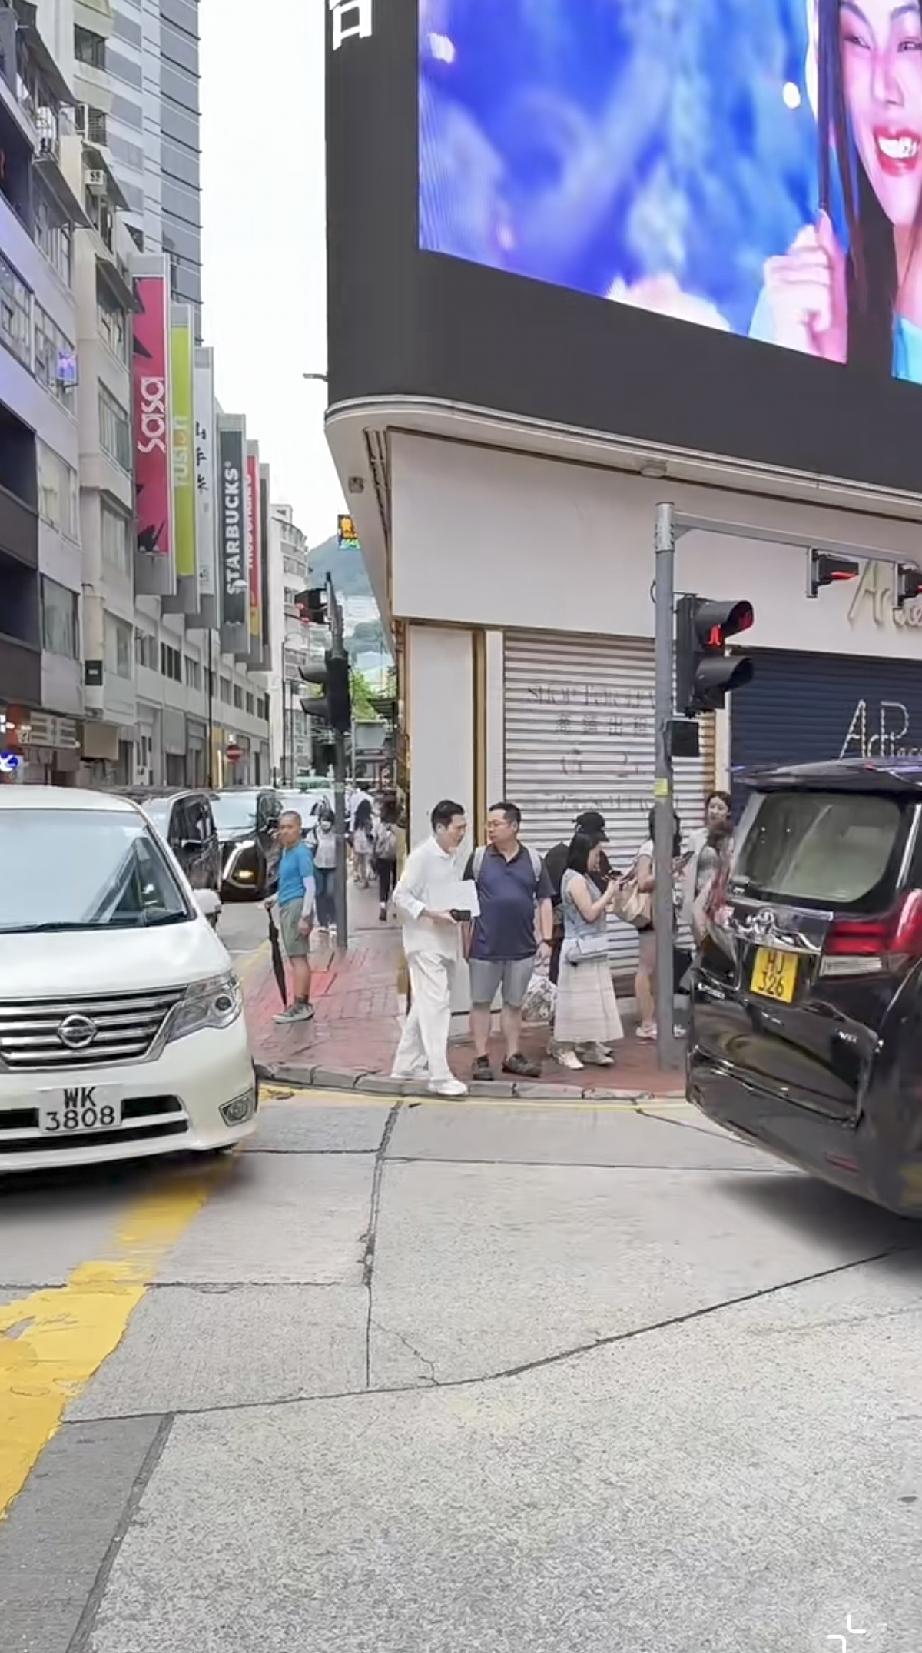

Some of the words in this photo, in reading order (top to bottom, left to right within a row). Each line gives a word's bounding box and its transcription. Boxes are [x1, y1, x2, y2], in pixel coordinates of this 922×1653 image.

[224, 466, 241, 596] STARBUCKS
[64, 1086, 96, 1109] WK
[45, 1105, 115, 1131] 3808
